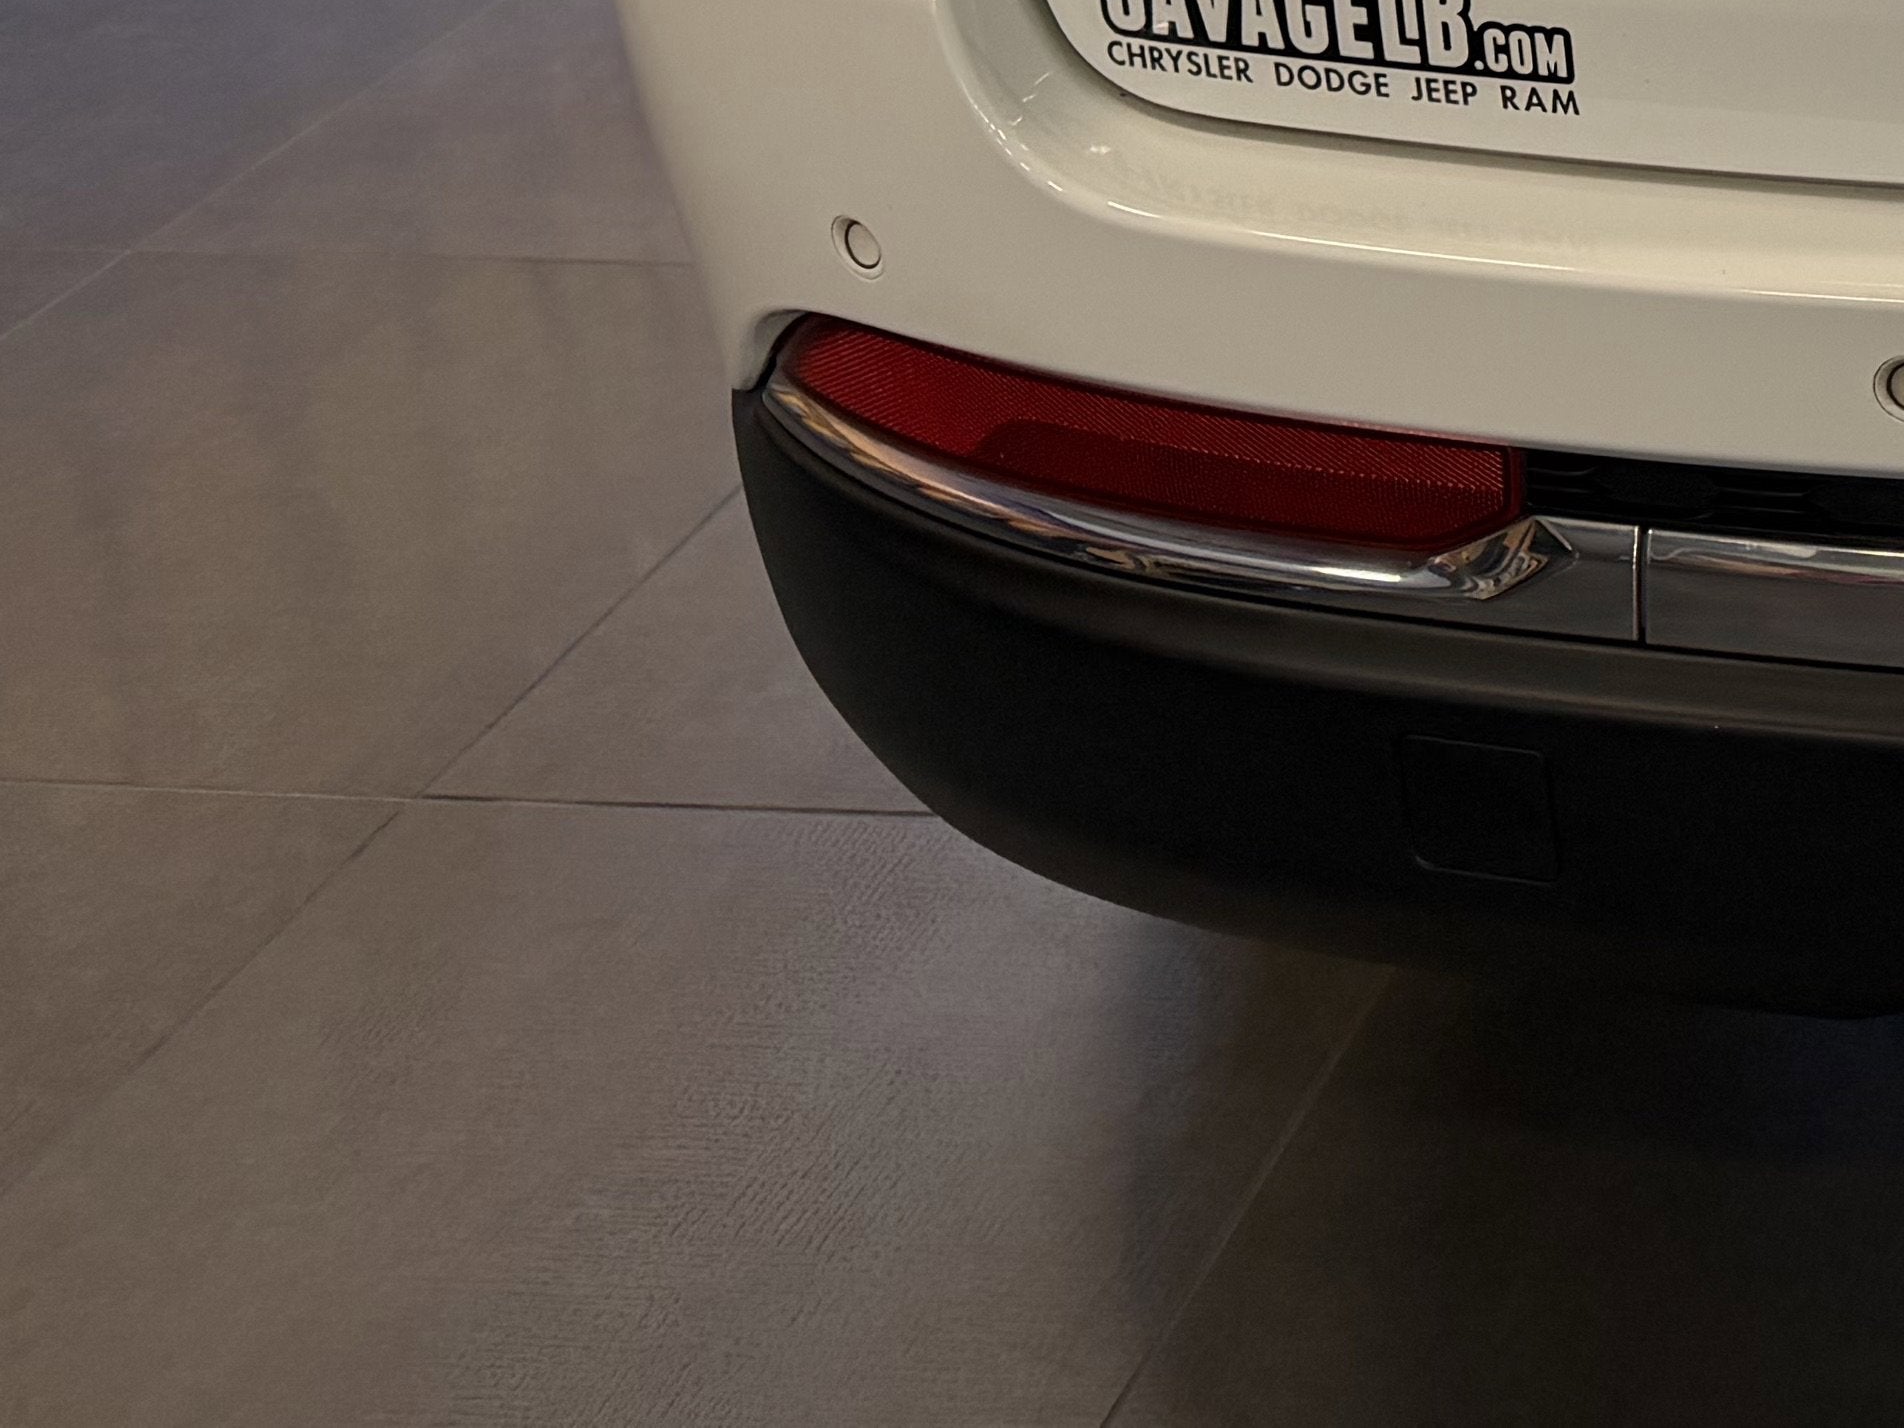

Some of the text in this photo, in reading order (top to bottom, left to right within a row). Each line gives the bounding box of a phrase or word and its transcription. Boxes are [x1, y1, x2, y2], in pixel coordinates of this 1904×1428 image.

[1107, 39, 1581, 116] CHRYSLER DODGE JEEP RAM
